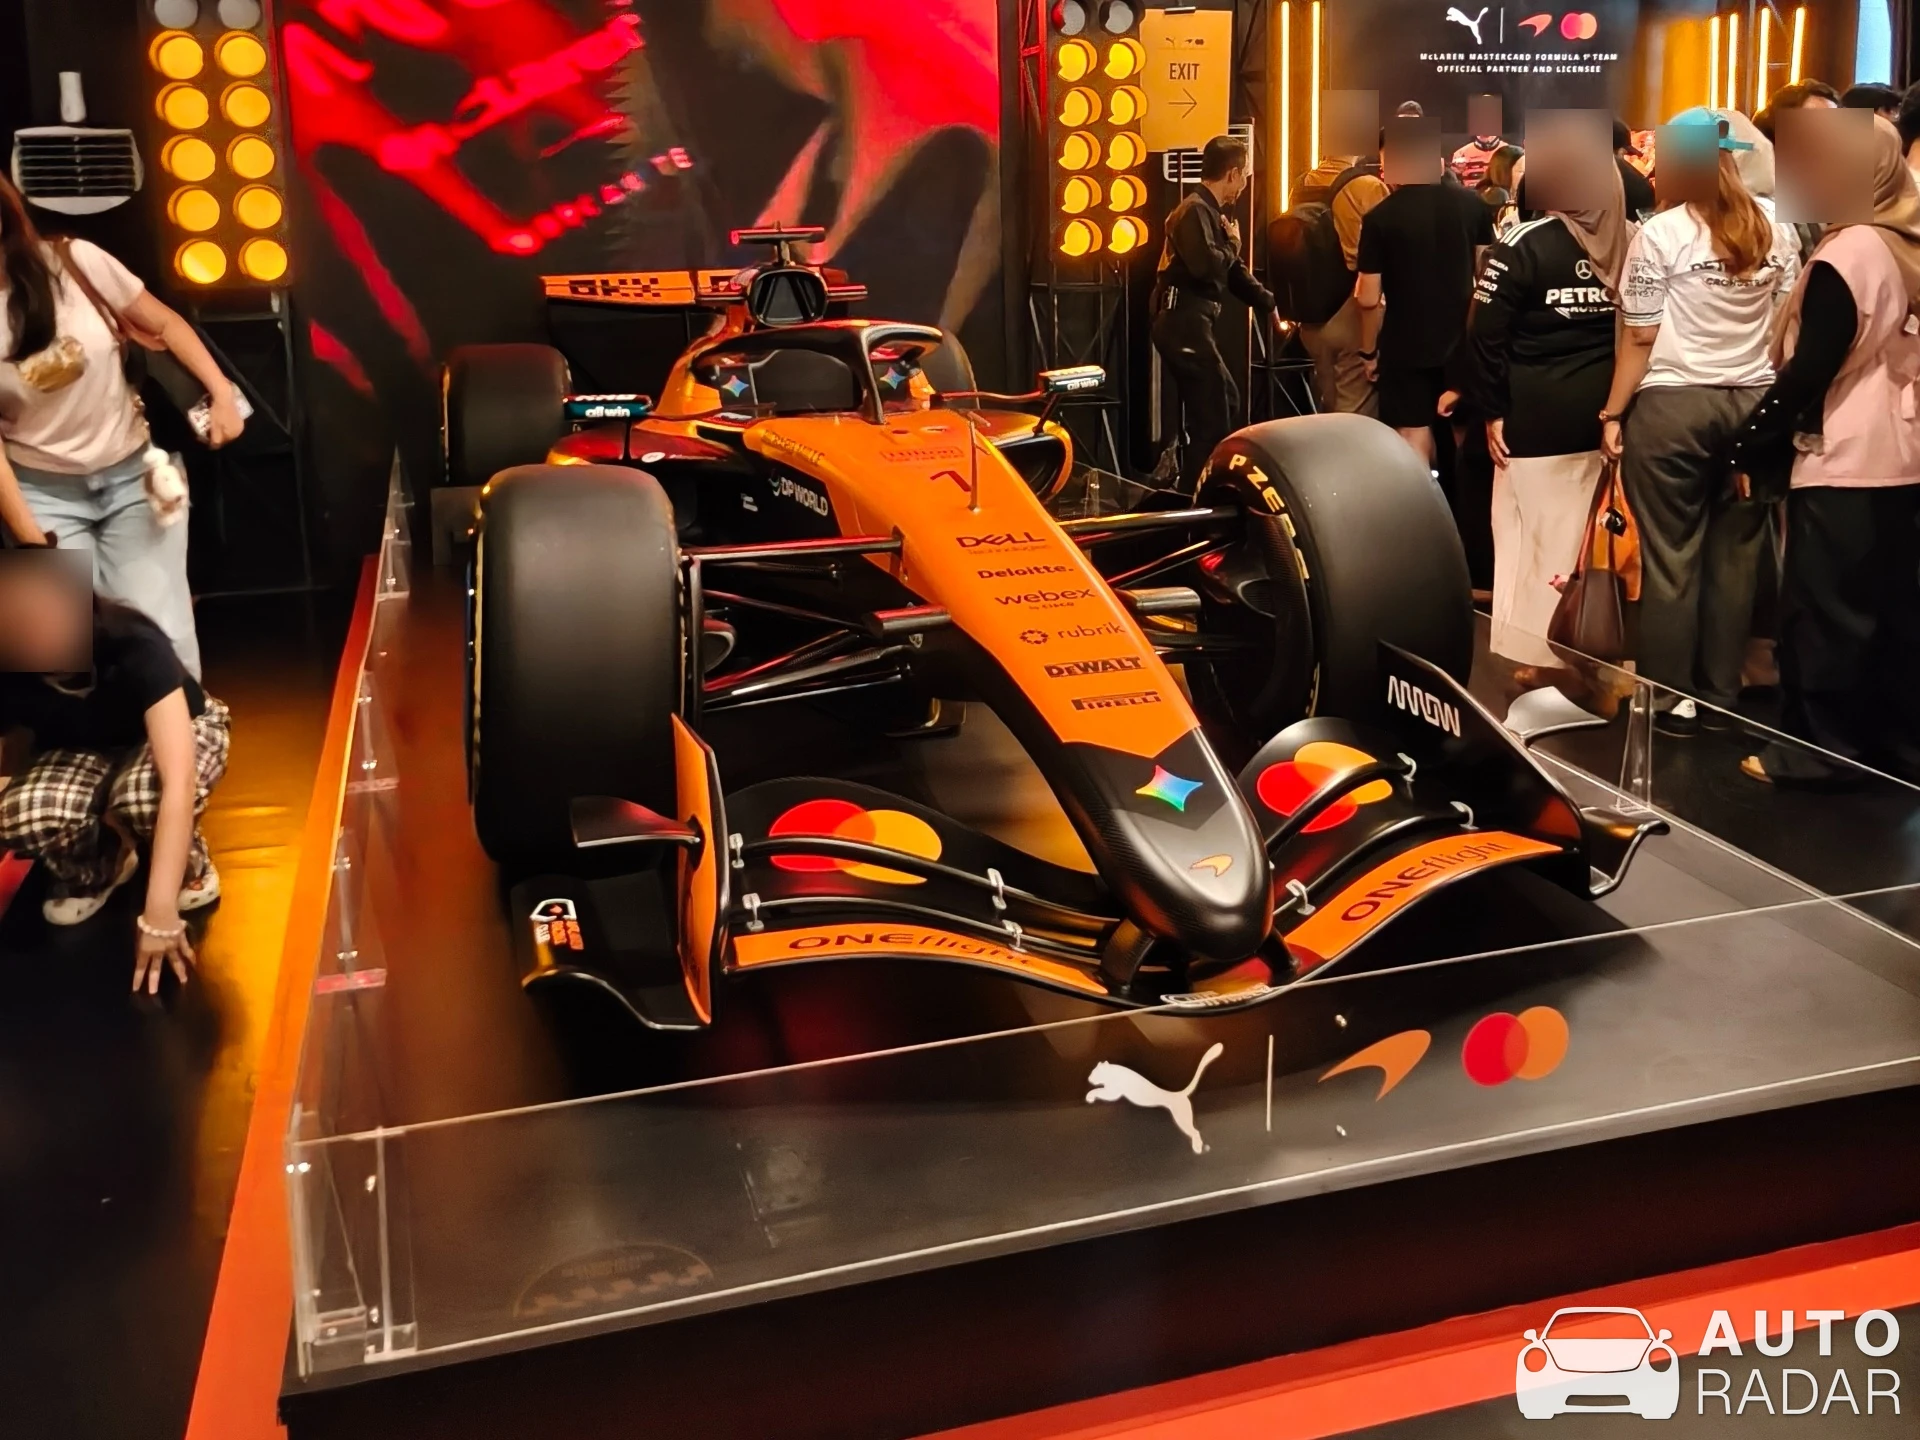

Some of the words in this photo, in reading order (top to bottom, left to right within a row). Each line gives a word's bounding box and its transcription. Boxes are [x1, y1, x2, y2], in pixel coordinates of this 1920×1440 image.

[1419, 53, 1465, 61] McLAREN
[1469, 53, 1533, 61] MASTERCARD
[1535, 53, 1581, 61] FORMULA
[1592, 53, 1619, 61] TEAM
[1169, 62, 1201, 81] EXIT
[1436, 65, 1483, 73] OFFICIAL
[1486, 65, 1530, 73] PARTNER
[1532, 65, 1552, 73] AND
[1556, 65, 1602, 73] LICENSEE
[794, 482, 829, 517] WORLD
[956, 532, 1046, 548] DELL
[977, 565, 1074, 579] Deloitte.
[995, 588, 1096, 606] webex
[1057, 621, 1126, 639] rubrik
[1071, 690, 1162, 711] PIRELLI
[1341, 842, 1514, 922] ONEflight
